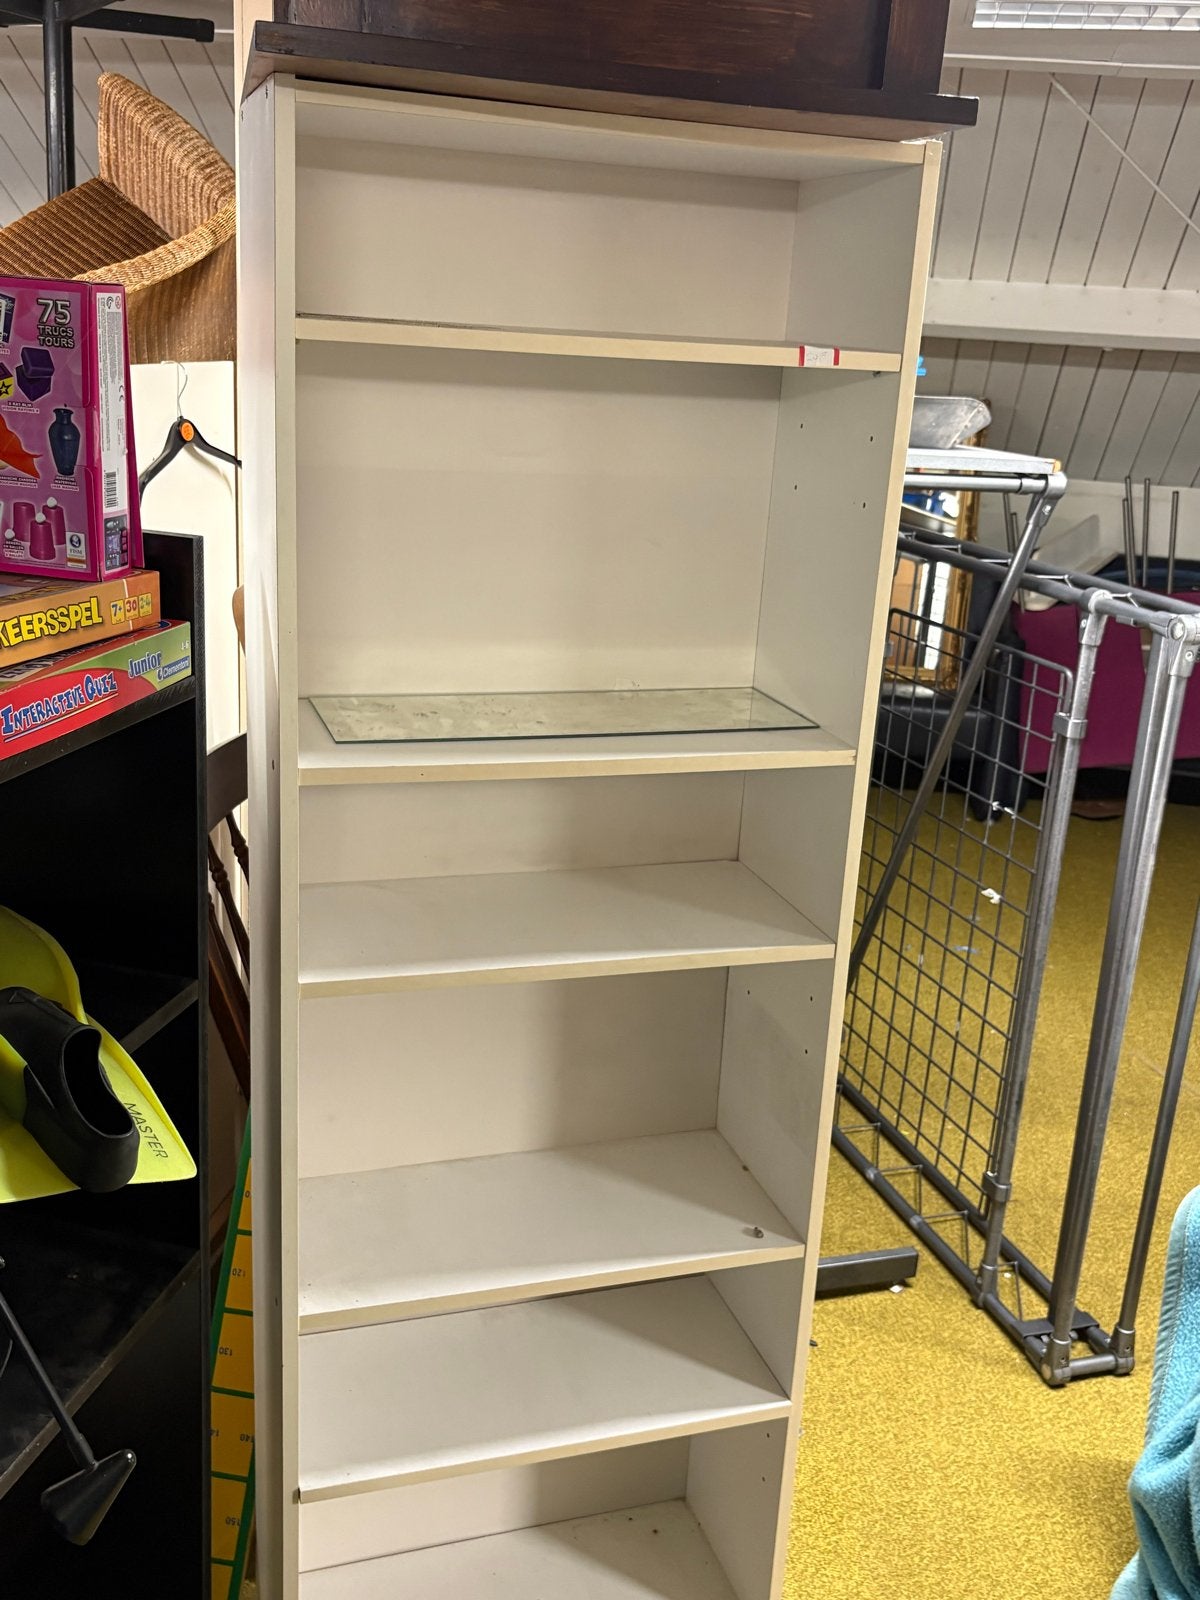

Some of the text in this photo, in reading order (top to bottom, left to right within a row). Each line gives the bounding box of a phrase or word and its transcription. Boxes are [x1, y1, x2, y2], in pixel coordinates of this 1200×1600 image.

[37, 298, 71, 325] 75
[37, 325, 74, 337] TRUCS
[38, 336, 75, 349] TOURS
[111, 603, 123, 617] 7+
[125, 599, 137, 613] 30
[128, 651, 162, 679] Junior
[123, 1102, 169, 1159] MASTER
[218, 1346, 233, 1356] 130
[225, 1516, 241, 1527] 150
